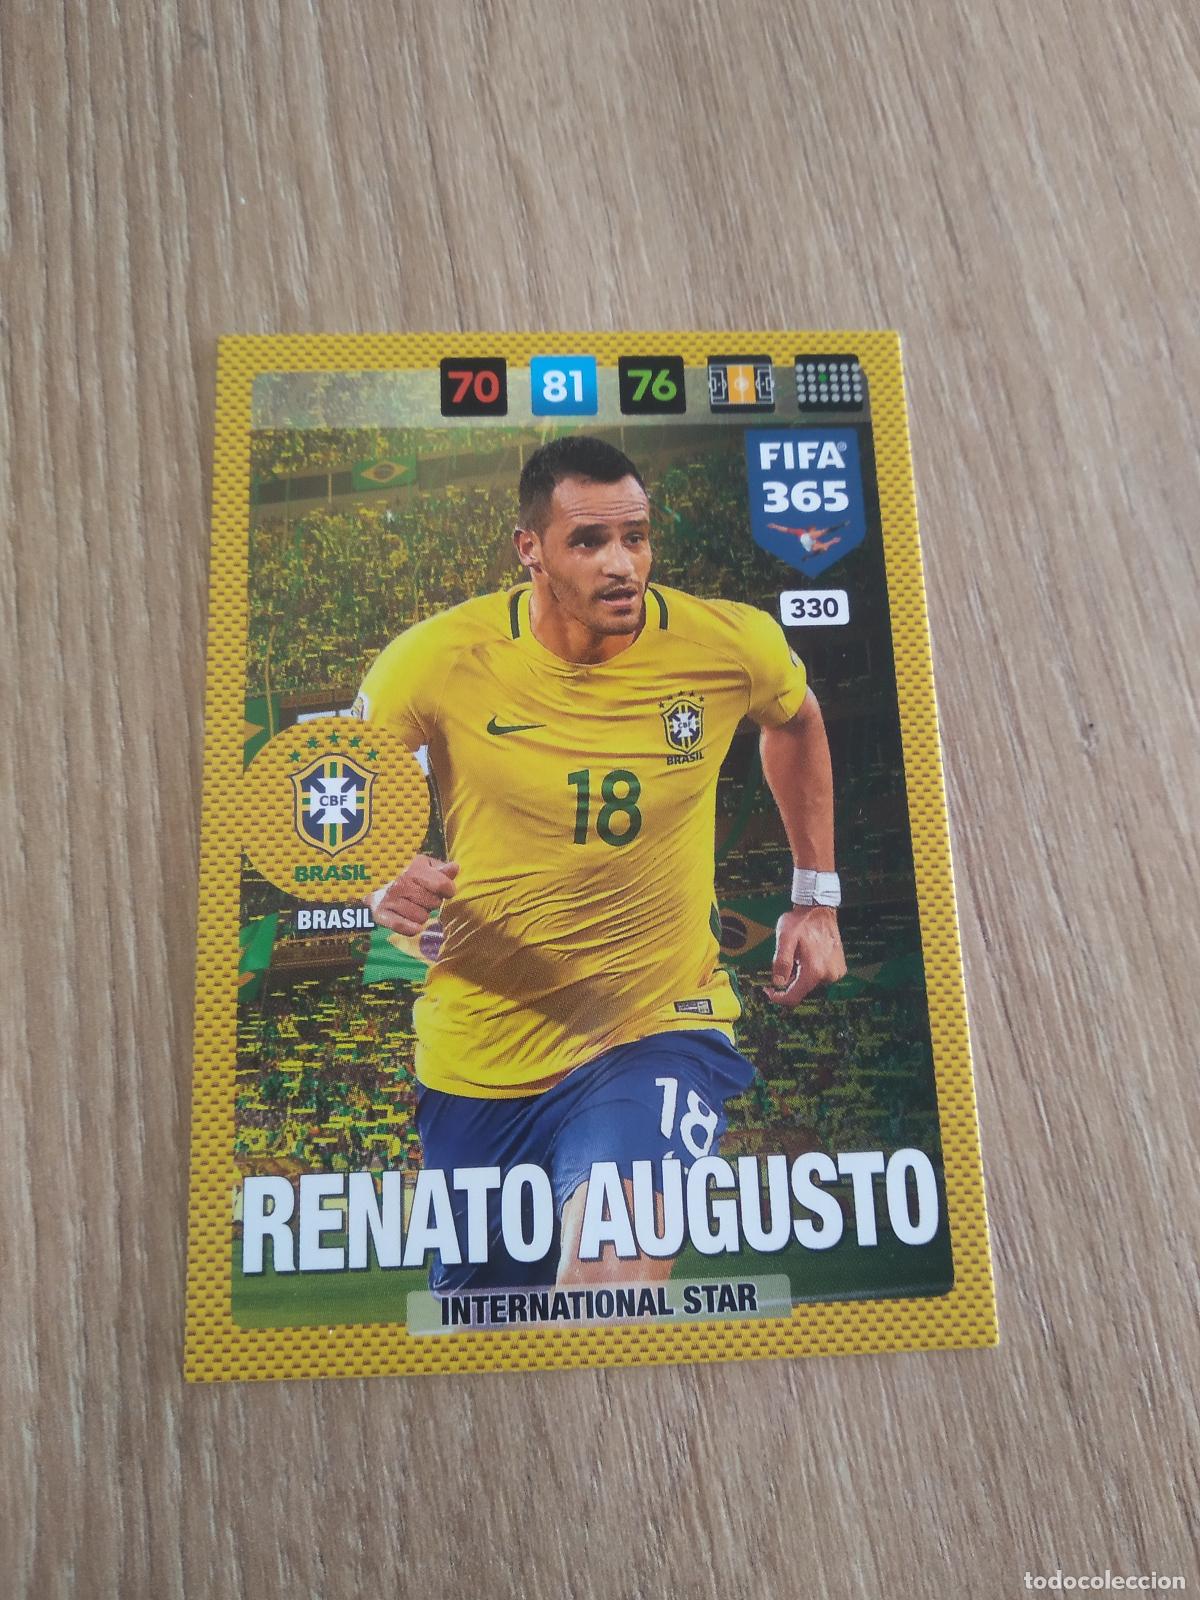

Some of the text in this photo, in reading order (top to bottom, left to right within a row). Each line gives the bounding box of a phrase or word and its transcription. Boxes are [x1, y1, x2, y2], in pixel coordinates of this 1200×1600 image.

[449, 370, 500, 403] 70
[542, 370, 585, 402] 81
[627, 369, 678, 401] 76
[762, 481, 849, 513] 365
[790, 598, 839, 618] 330
[666, 752, 704, 766] BRASIL
[319, 795, 348, 806] CBF
[567, 769, 642, 846] 18
[294, 864, 371, 882] BRASIL
[297, 908, 375, 931] BRASIL
[242, 1148, 940, 1275] RENATO AUGUSTO
[440, 1283, 758, 1326] INTERNATIONAL STAR
